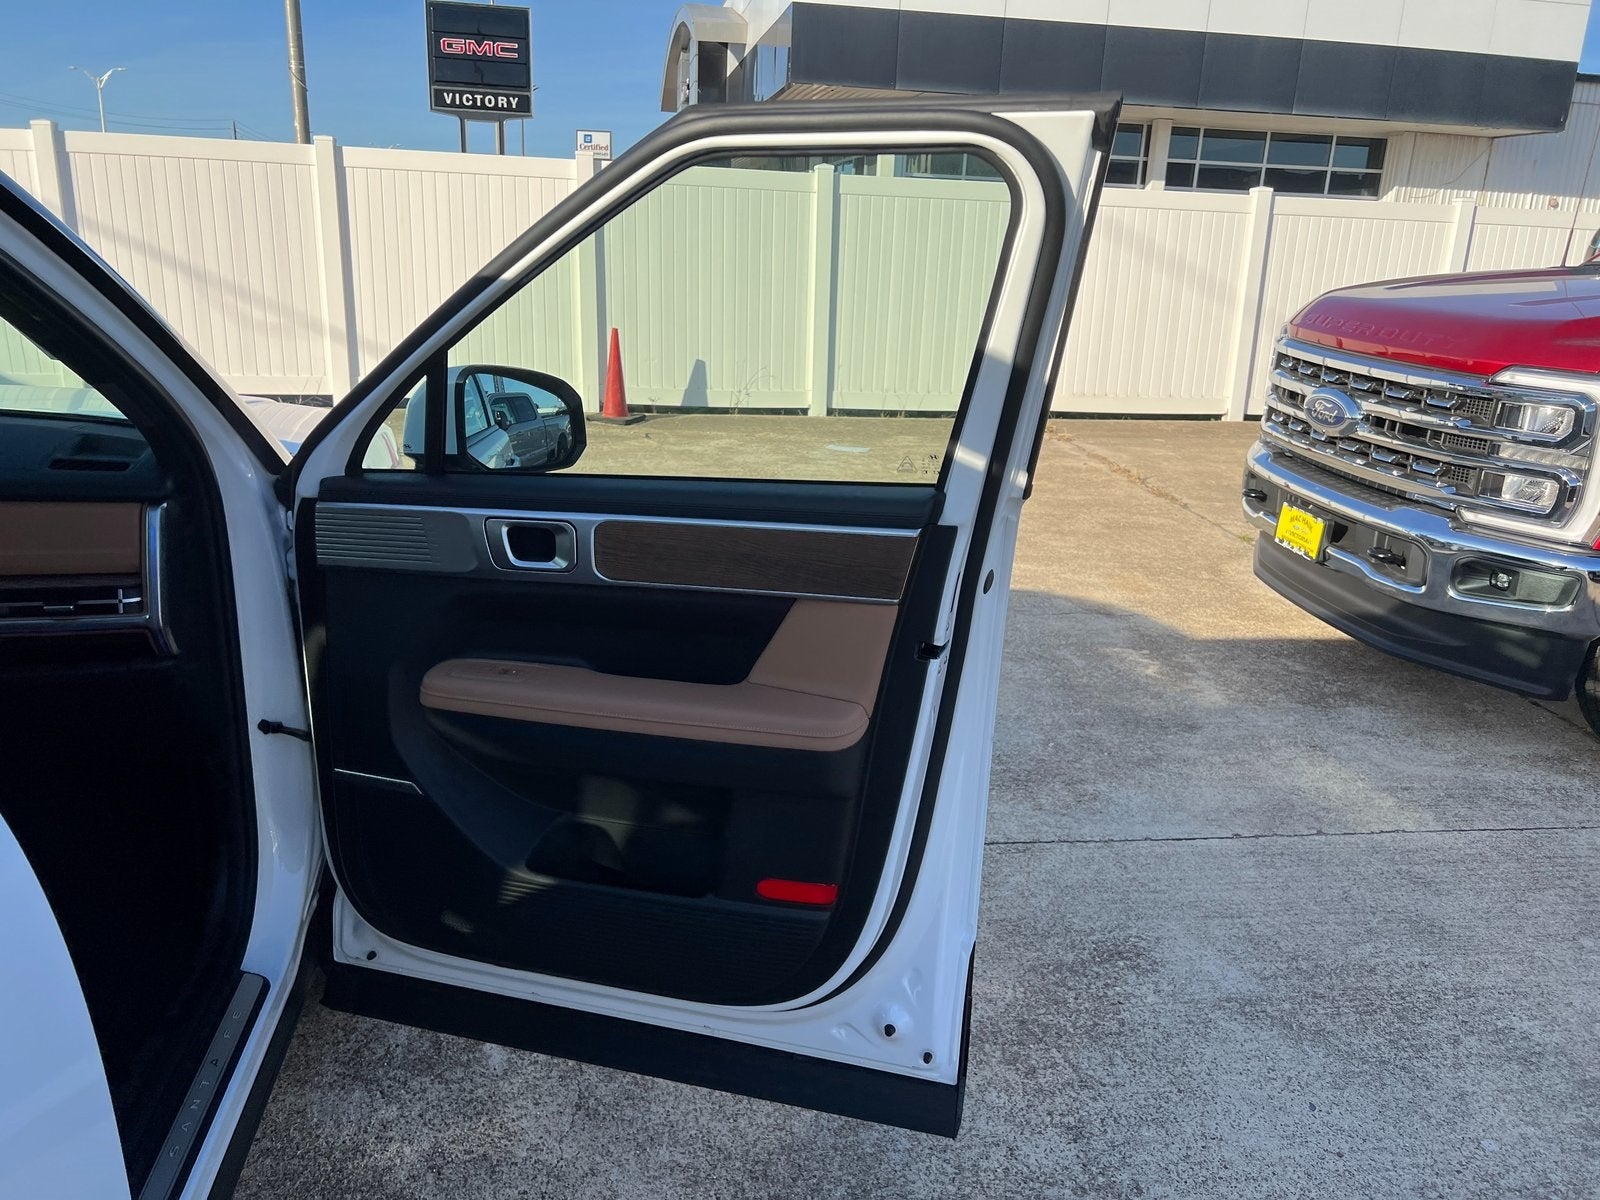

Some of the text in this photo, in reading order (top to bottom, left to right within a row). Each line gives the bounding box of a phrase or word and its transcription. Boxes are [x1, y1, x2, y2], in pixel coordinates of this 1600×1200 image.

[440, 37, 519, 58] GMC
[443, 92, 519, 109] VICTORY
[579, 143, 609, 151] Certified
[1311, 400, 1338, 423] Ford
[169, 1058, 219, 1157] SANTA
